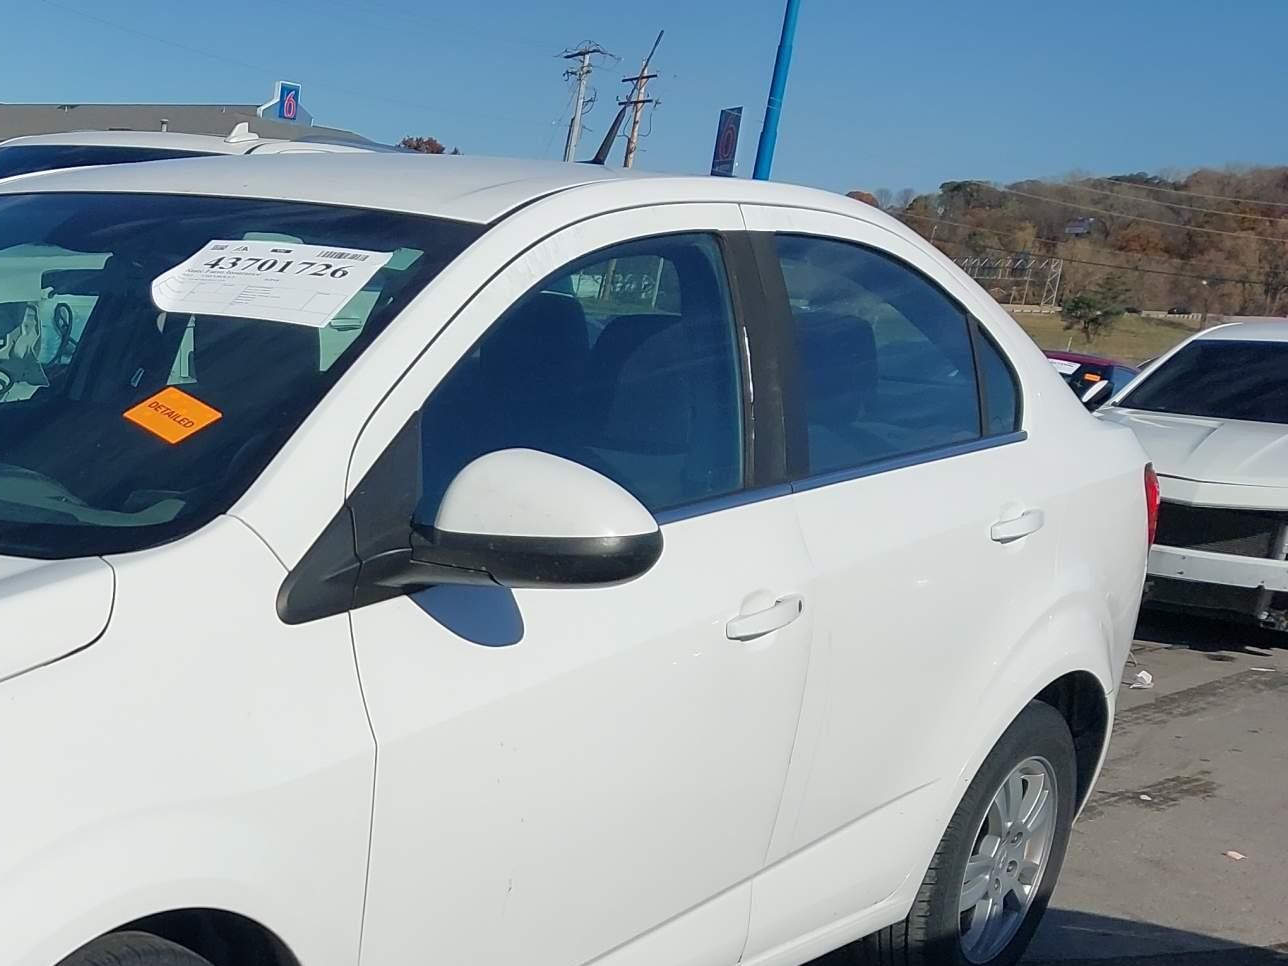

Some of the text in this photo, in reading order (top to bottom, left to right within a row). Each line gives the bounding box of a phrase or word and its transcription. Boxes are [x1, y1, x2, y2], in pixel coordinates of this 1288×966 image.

[283, 90, 297, 119] 6
[203, 255, 355, 280] 43701726
[147, 400, 195, 429] DETAILED
